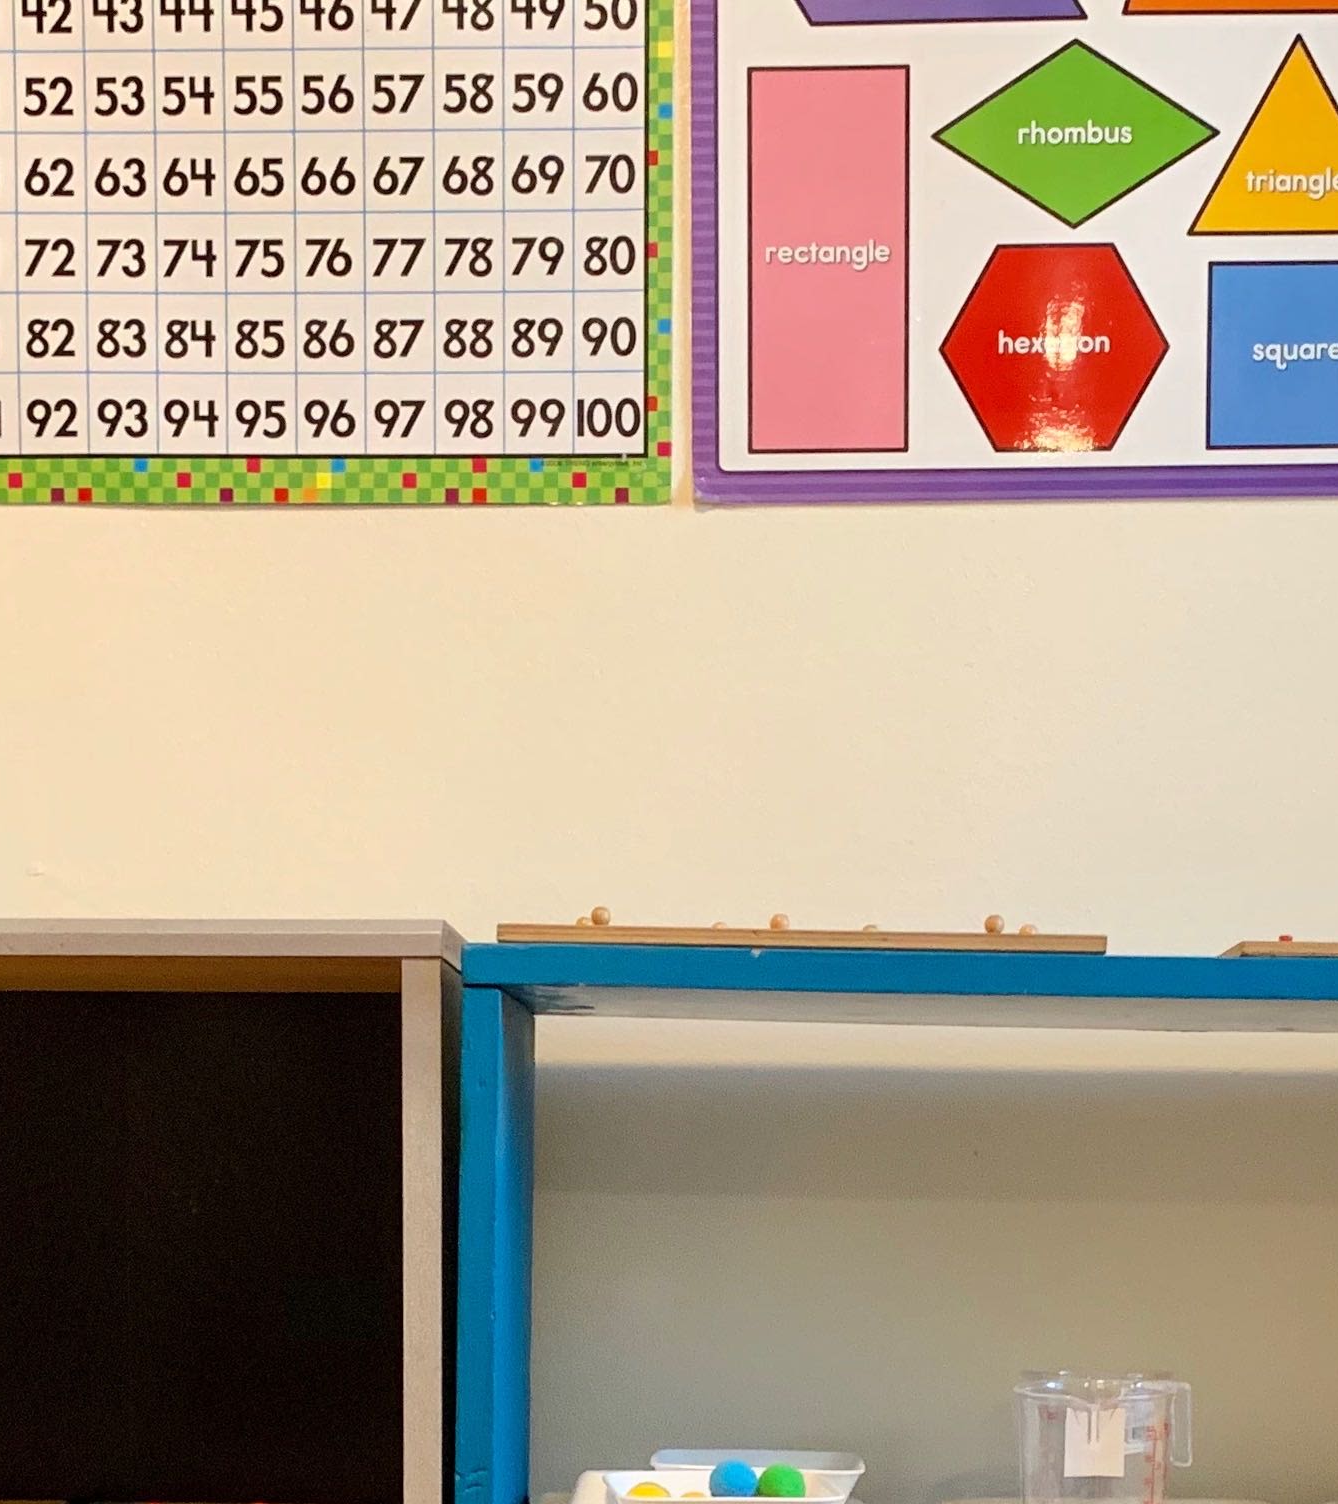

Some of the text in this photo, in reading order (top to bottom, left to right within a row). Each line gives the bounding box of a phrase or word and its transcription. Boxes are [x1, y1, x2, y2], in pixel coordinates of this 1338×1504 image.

[22, 0, 71, 33] 42
[93, 0, 143, 33] 43
[163, 0, 213, 32] 44
[234, 0, 283, 31] 45
[301, 0, 353, 30] 46
[372, 0, 420, 30] 47
[443, 0, 493, 30] 48
[512, 0, 564, 29] 49
[585, 0, 637, 29] 50
[24, 77, 73, 115] 52
[95, 77, 144, 116] 53
[163, 77, 214, 115] 54
[234, 76, 282, 114] 55
[302, 75, 353, 114] 56
[373, 75, 424, 113] 57
[444, 74, 493, 113] 58
[513, 74, 563, 112] 59
[583, 73, 637, 111] 60
[1017, 119, 1133, 145] rhombus
[25, 159, 74, 196] 62
[95, 159, 146, 197] 63
[164, 158, 215, 196] 64
[235, 158, 283, 196] 65
[302, 157, 355, 195] 66
[374, 157, 424, 194] 67
[443, 156, 494, 195] 68
[512, 156, 564, 193] 69
[586, 155, 635, 193] 70
[26, 239, 74, 276] 72
[98, 239, 145, 277] 73
[164, 240, 216, 276] 74
[236, 240, 284, 277] 75
[306, 239, 352, 276] 76
[374, 239, 425, 276] 77
[446, 238, 492, 276] 78
[513, 237, 563, 275] 79
[585, 236, 635, 275] 80
[765, 239, 890, 270] rectangle
[27, 319, 74, 357] 82
[97, 319, 146, 357] 83
[166, 320, 215, 358] 84
[236, 320, 284, 358] 85
[304, 320, 354, 358] 86
[374, 320, 424, 358] 87
[444, 319, 493, 358] 88
[512, 319, 562, 357] 89
[583, 318, 636, 356] 90
[998, 329, 1111, 360] hexon
[27, 399, 77, 437] 92
[98, 399, 147, 437] 93
[164, 400, 218, 437] 94
[236, 400, 286, 438] 95
[305, 400, 355, 437] 96
[375, 400, 425, 437] 97
[445, 400, 494, 438] 98
[512, 399, 564, 436] 99
[577, 399, 640, 437] 100
